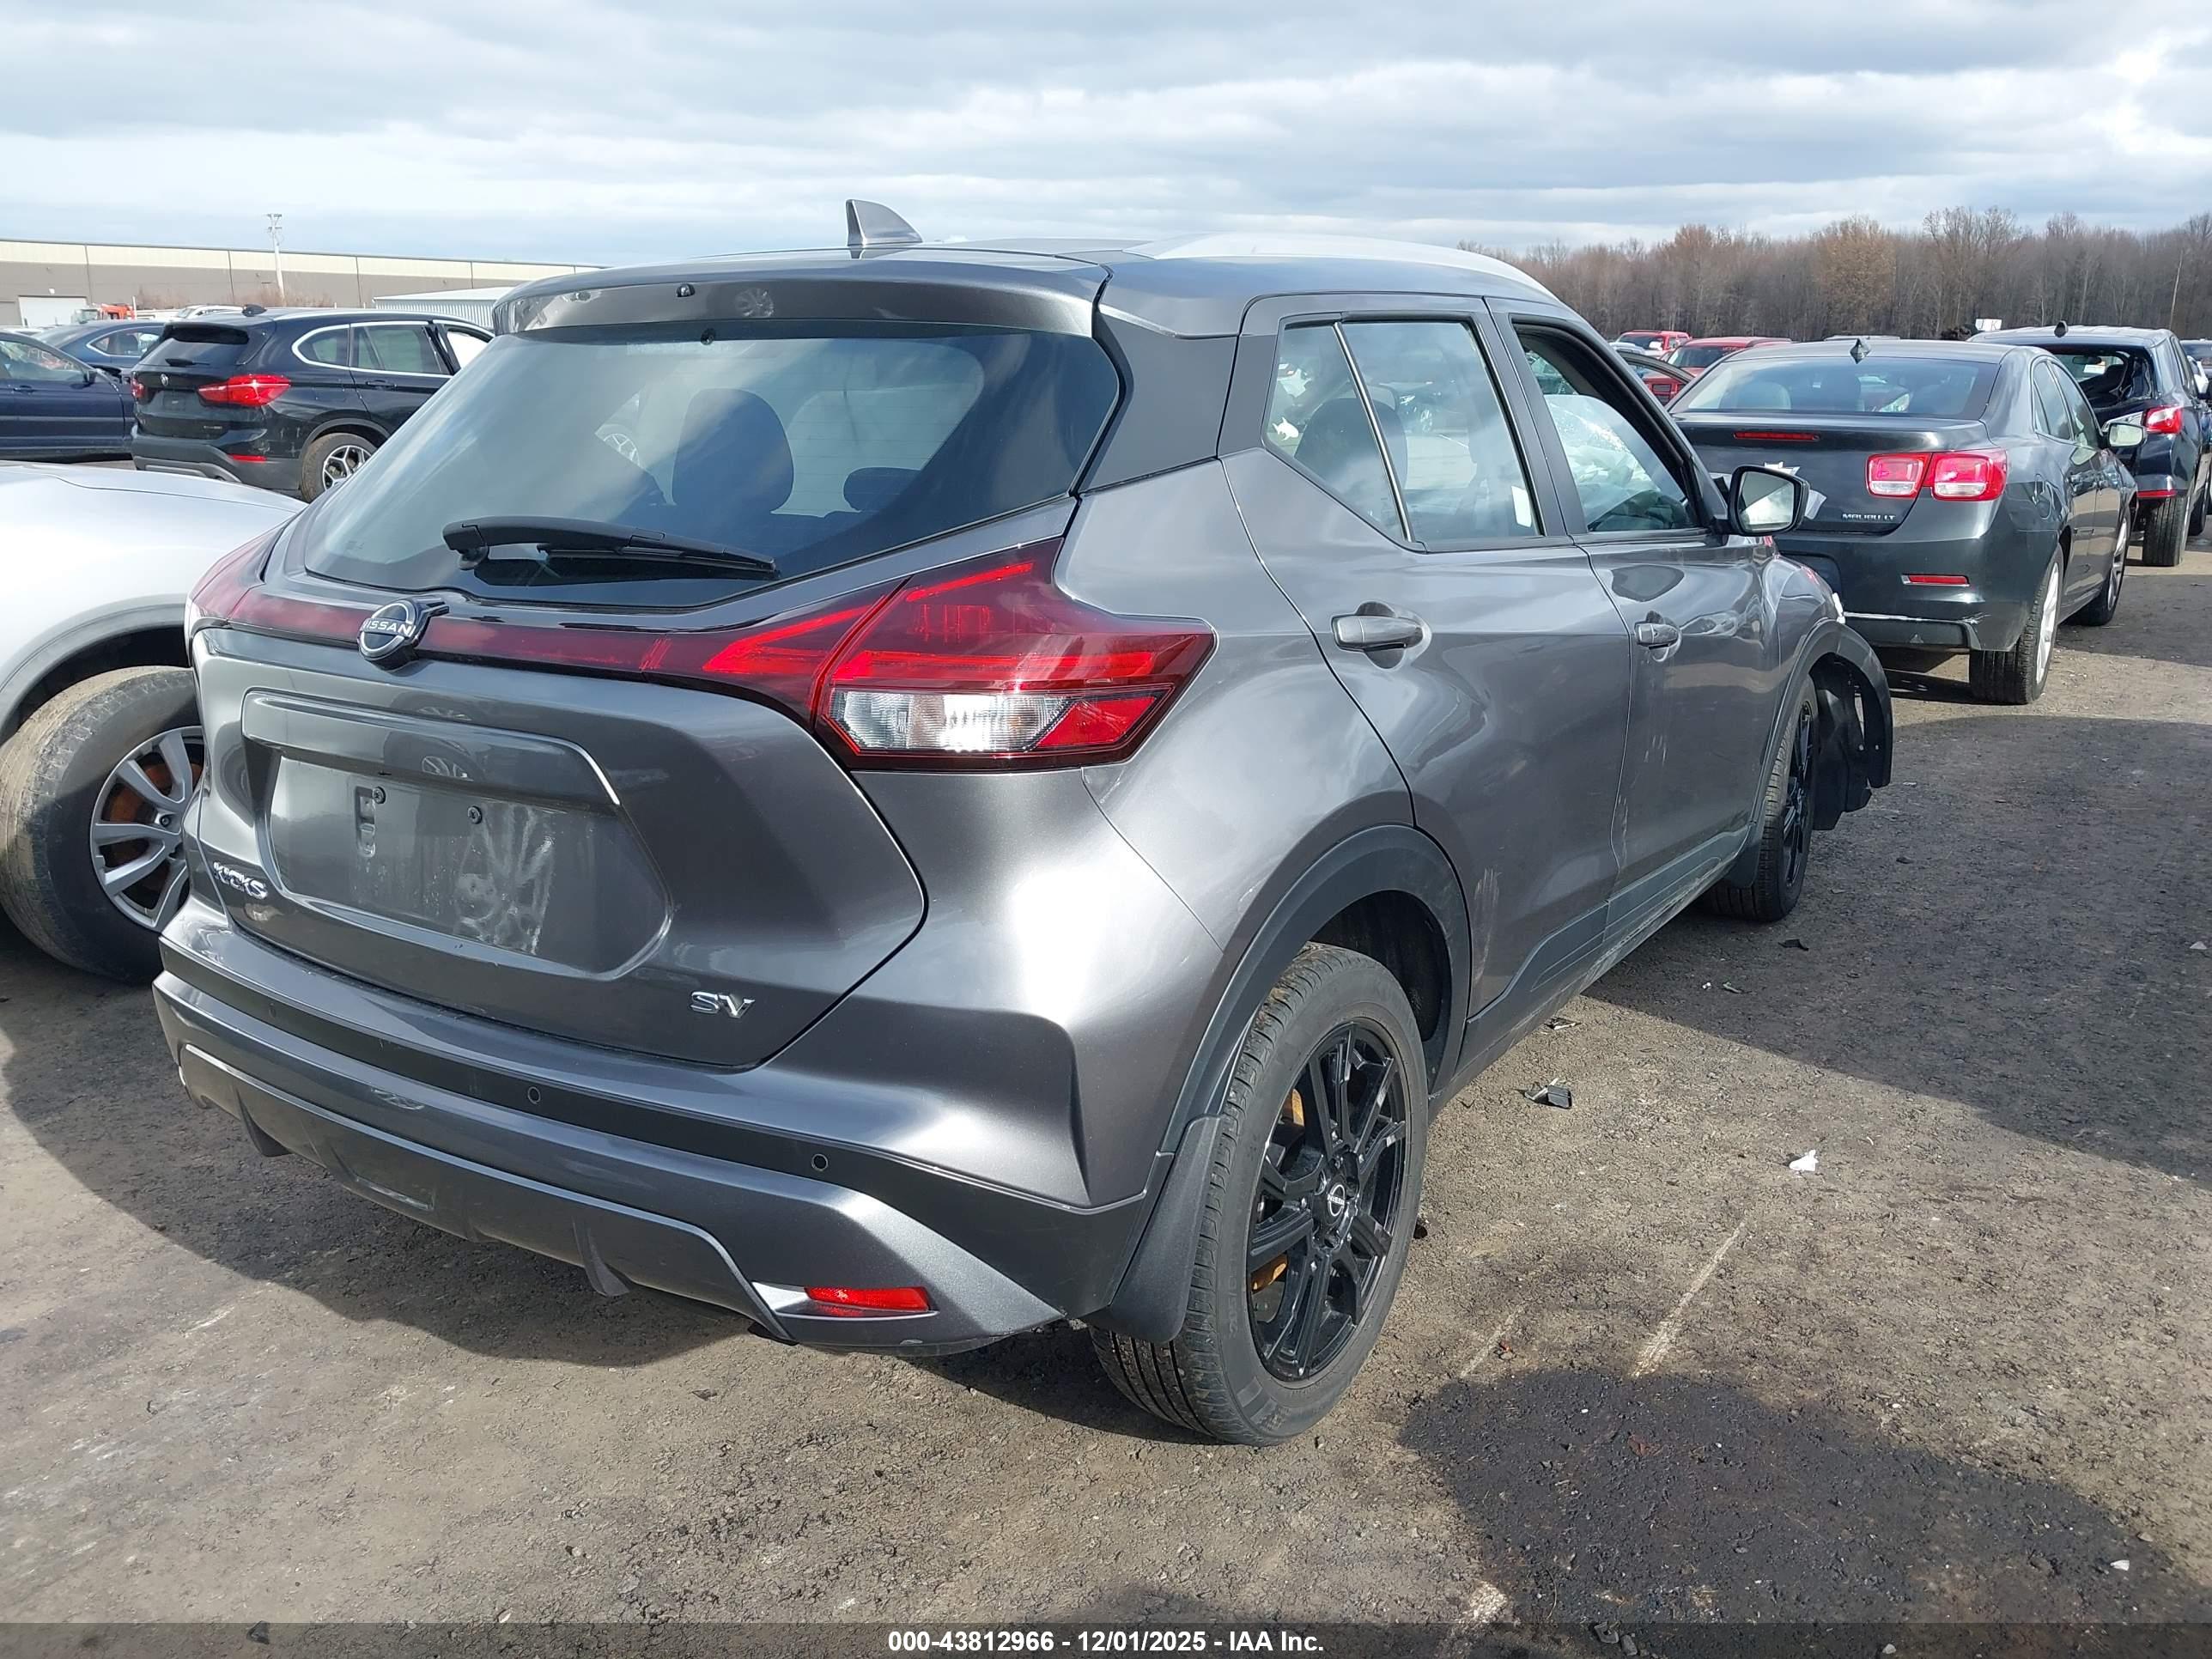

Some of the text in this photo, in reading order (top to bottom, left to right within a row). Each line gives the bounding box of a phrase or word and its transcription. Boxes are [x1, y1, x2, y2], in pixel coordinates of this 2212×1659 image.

[360, 618, 416, 638] NISSAN
[213, 861, 268, 899] KICKS
[690, 991, 756, 1018] SV
